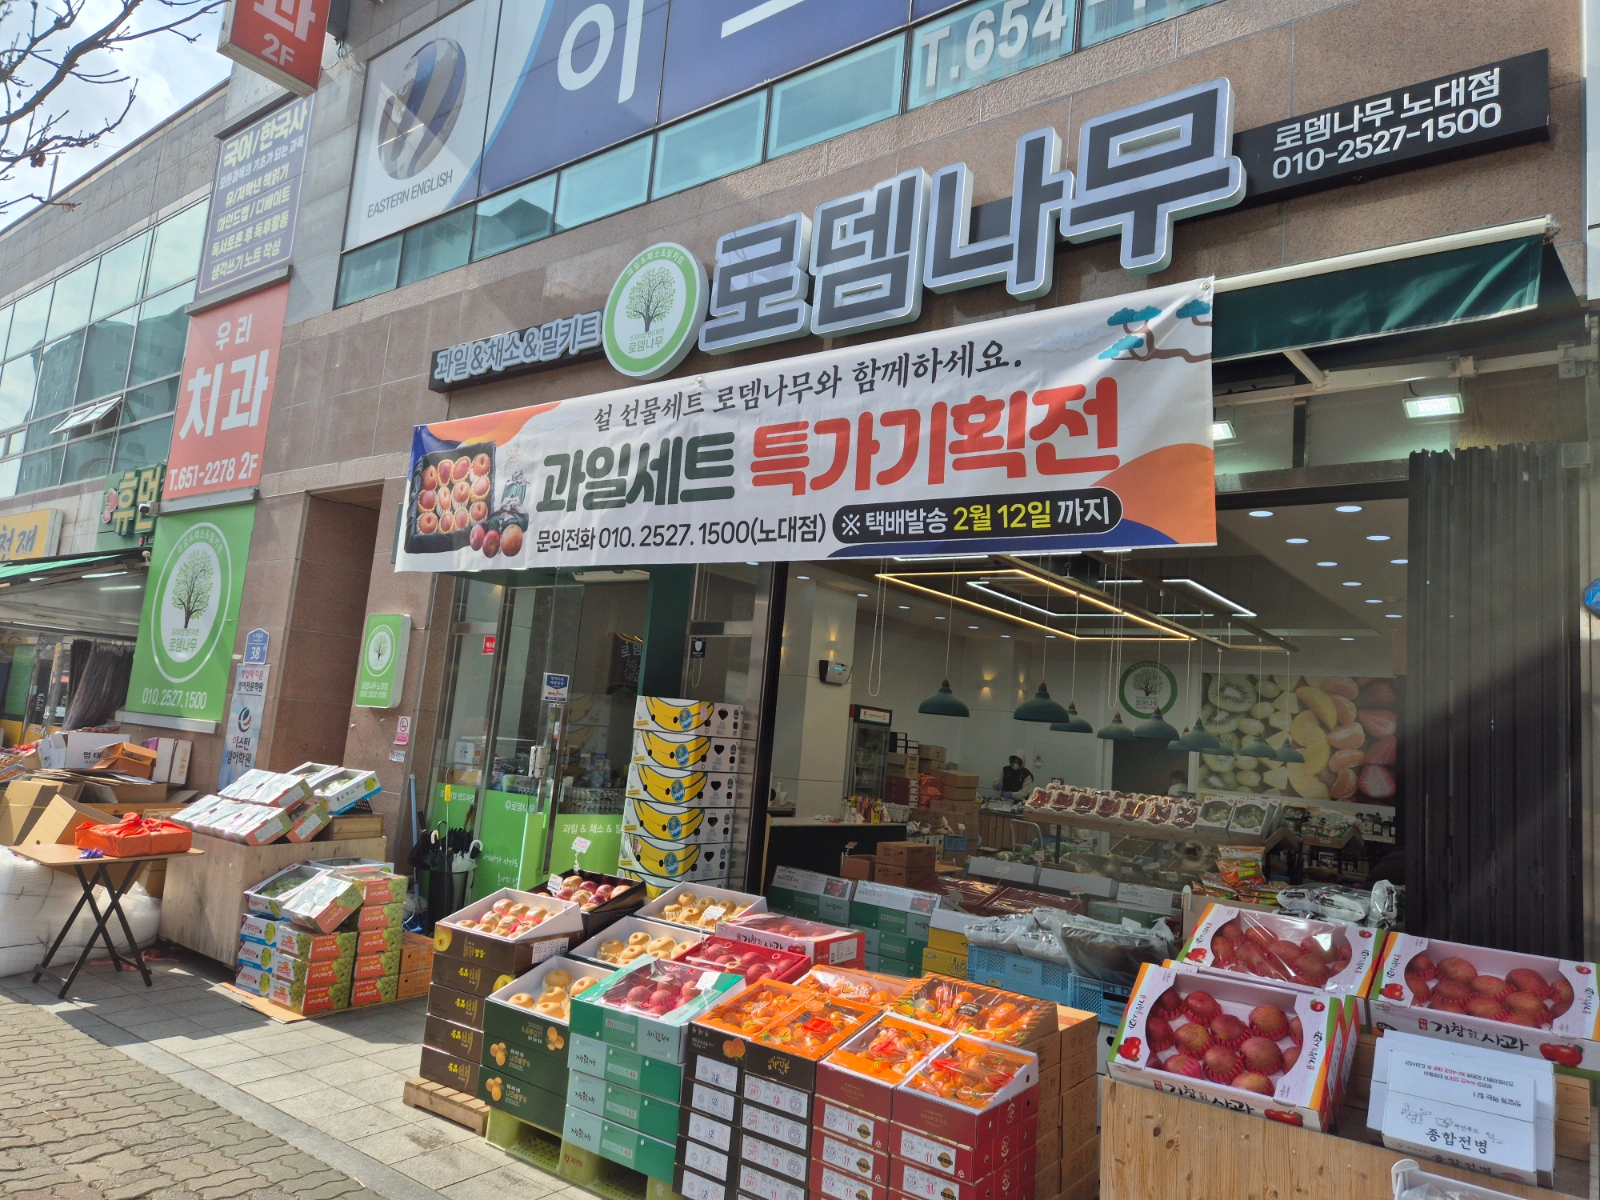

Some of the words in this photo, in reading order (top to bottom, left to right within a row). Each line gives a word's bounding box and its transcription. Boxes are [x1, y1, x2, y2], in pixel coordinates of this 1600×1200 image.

[261, 33, 295, 67] 2F
[1273, 97, 1394, 152] 로뎀나무
[1400, 67, 1501, 119] 노대점
[1273, 102, 1502, 180] 010-2527-1500
[367, 191, 409, 218] EASTERN
[410, 169, 454, 200] ENGLISH
[698, 77, 1247, 354] 로뎀나무
[244, 246, 262, 267] 노트
[263, 238, 281, 258] 작성
[215, 314, 253, 350] 우리
[628, 335, 663, 353] 로뎀나무
[179, 349, 269, 440] 치과
[594, 402, 614, 433] 설
[620, 391, 704, 427] 선물세트
[712, 365, 842, 414] 로뎀나무와
[852, 339, 1022, 392] 함께하세요.
[536, 431, 736, 513] 과일세트
[749, 376, 1120, 496] 특가기획전
[169, 459, 236, 491] T.651-2278
[238, 452, 259, 480] 2F
[865, 507, 948, 536] 택배발송
[952, 503, 992, 532] 2월
[997, 500, 1051, 529] 12일
[1057, 496, 1110, 525] 까지
[536, 524, 596, 553] 문의전화
[168, 638, 197, 653] 로뎀나무
[250, 646, 261, 660] 38
[142, 687, 208, 710] 010.2527.1500
[232, 736, 250, 750] 이스턴
[226, 751, 251, 767] 영어학원
[562, 824, 579, 834] 과일
[589, 824, 604, 834] 채소
[1481, 1033, 1529, 1051] 사과
[1212, 1096, 1254, 1114] 사과
[1426, 1127, 1488, 1154] 종합전병
